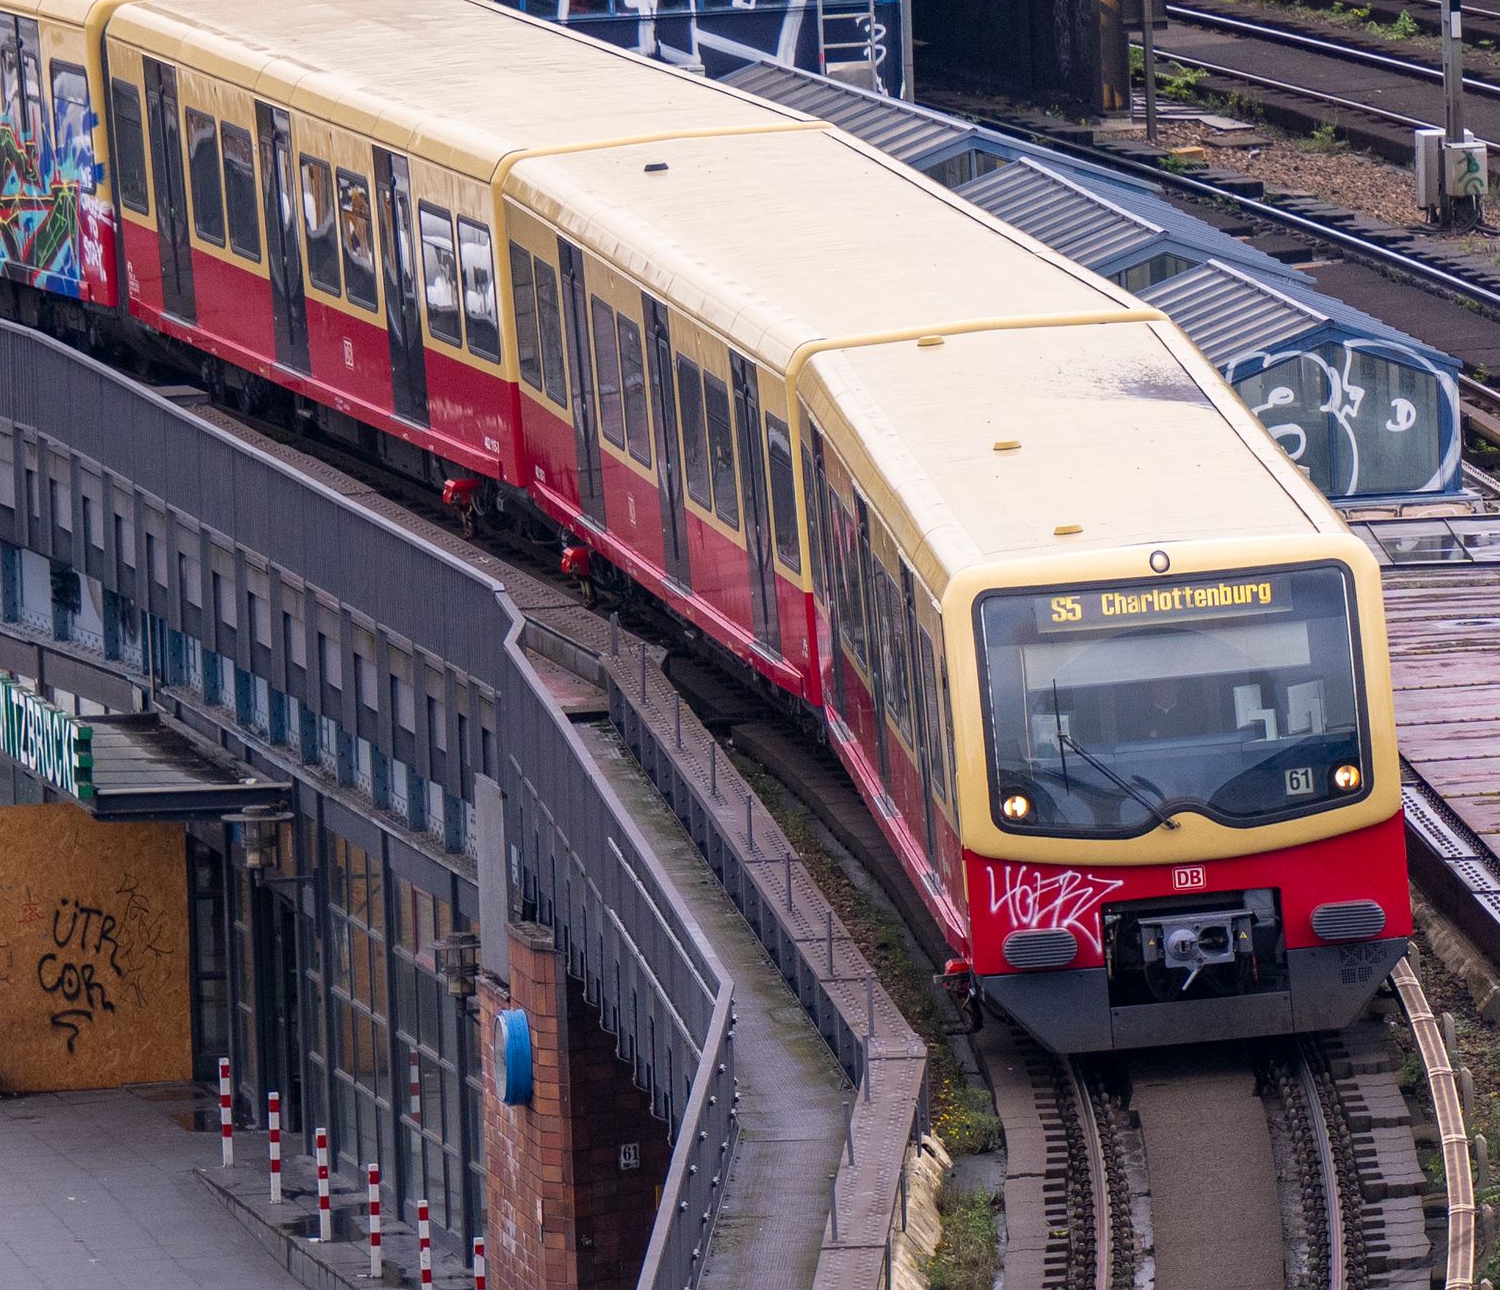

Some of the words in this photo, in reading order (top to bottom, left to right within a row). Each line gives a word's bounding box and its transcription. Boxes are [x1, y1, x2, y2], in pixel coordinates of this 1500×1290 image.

[1051, 595, 1082, 622] S5
[1102, 582, 1271, 616] Charlottenburg
[1289, 768, 1310, 791] 61
[622, 1145, 638, 1161] 61
